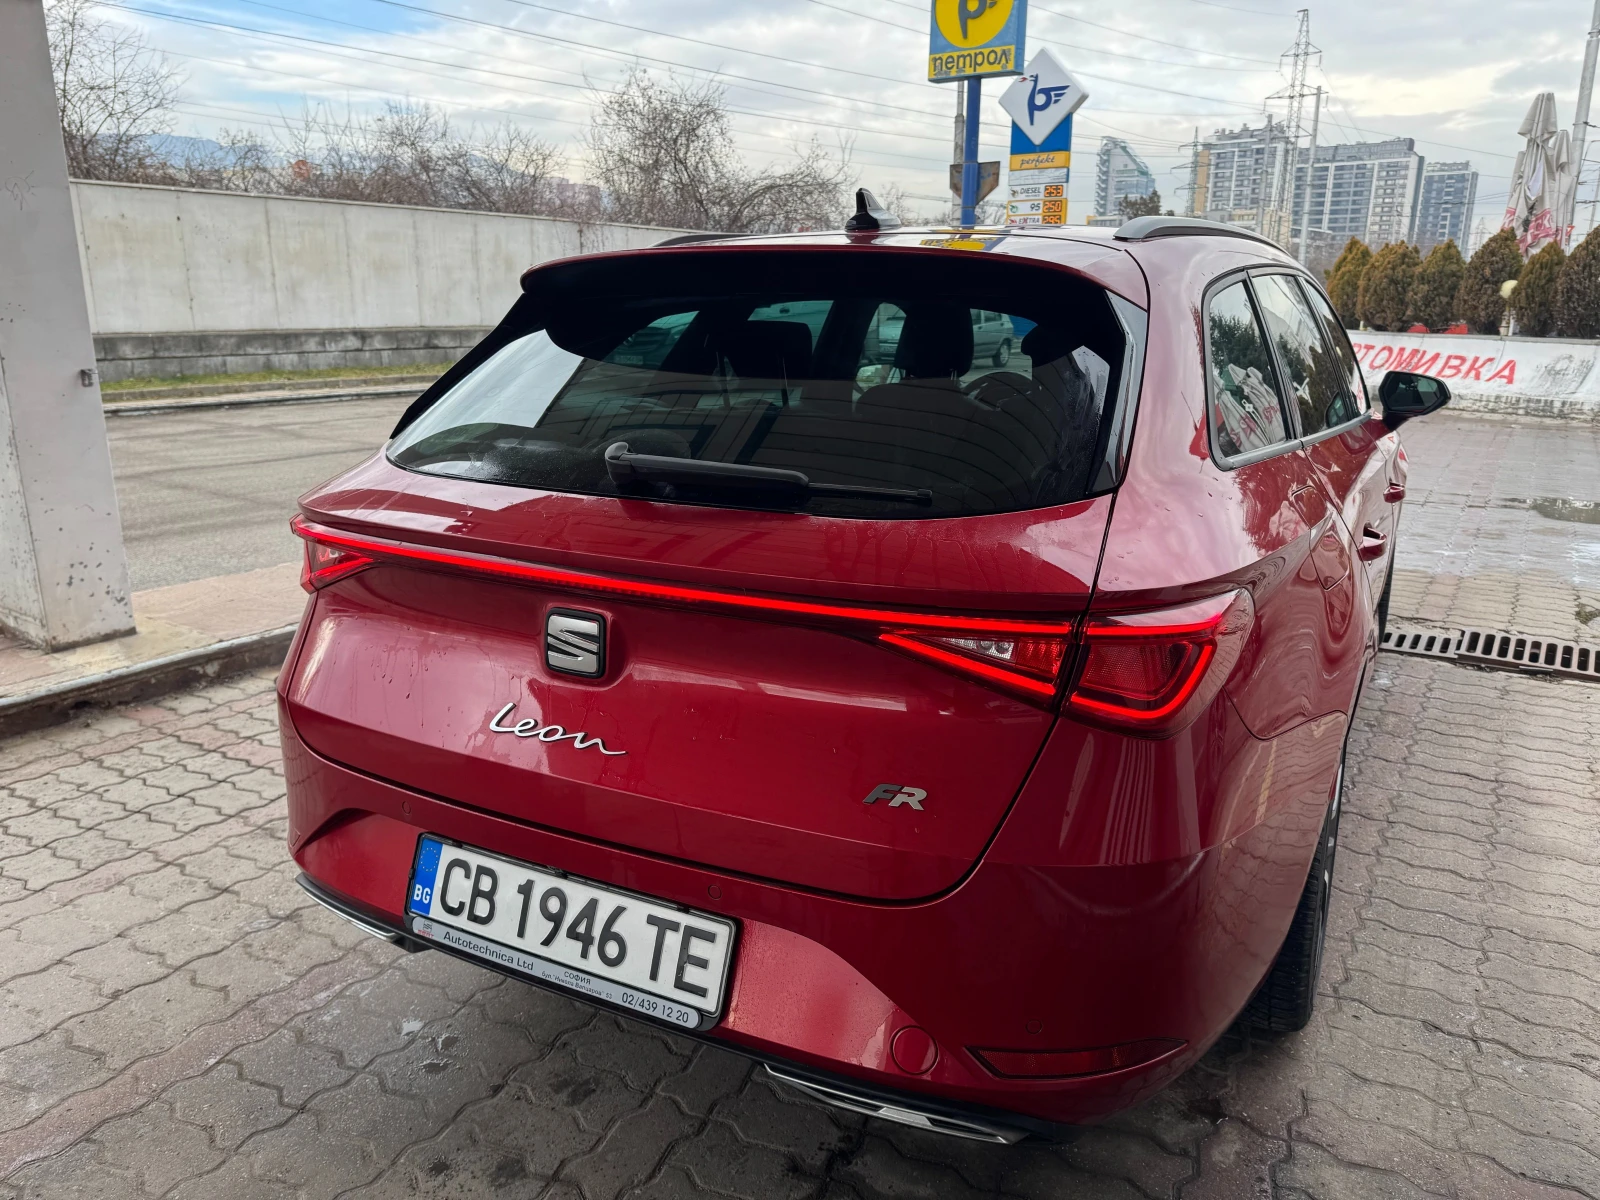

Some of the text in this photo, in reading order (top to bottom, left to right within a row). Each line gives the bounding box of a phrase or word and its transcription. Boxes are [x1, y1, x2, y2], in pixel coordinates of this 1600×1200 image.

[1020, 187, 1041, 195] DIESEL
[1045, 186, 1063, 197] 253
[1030, 201, 1061, 212] 95 250
[489, 702, 627, 755] Leon
[862, 783, 928, 810] FR
[413, 884, 431, 904] BG
[440, 858, 716, 998] CB 1946 TE
[443, 931, 534, 971] Autotechnica Ltd
[564, 971, 591, 985] СОФИЯ
[622, 992, 689, 1023] 02/439 12 20
